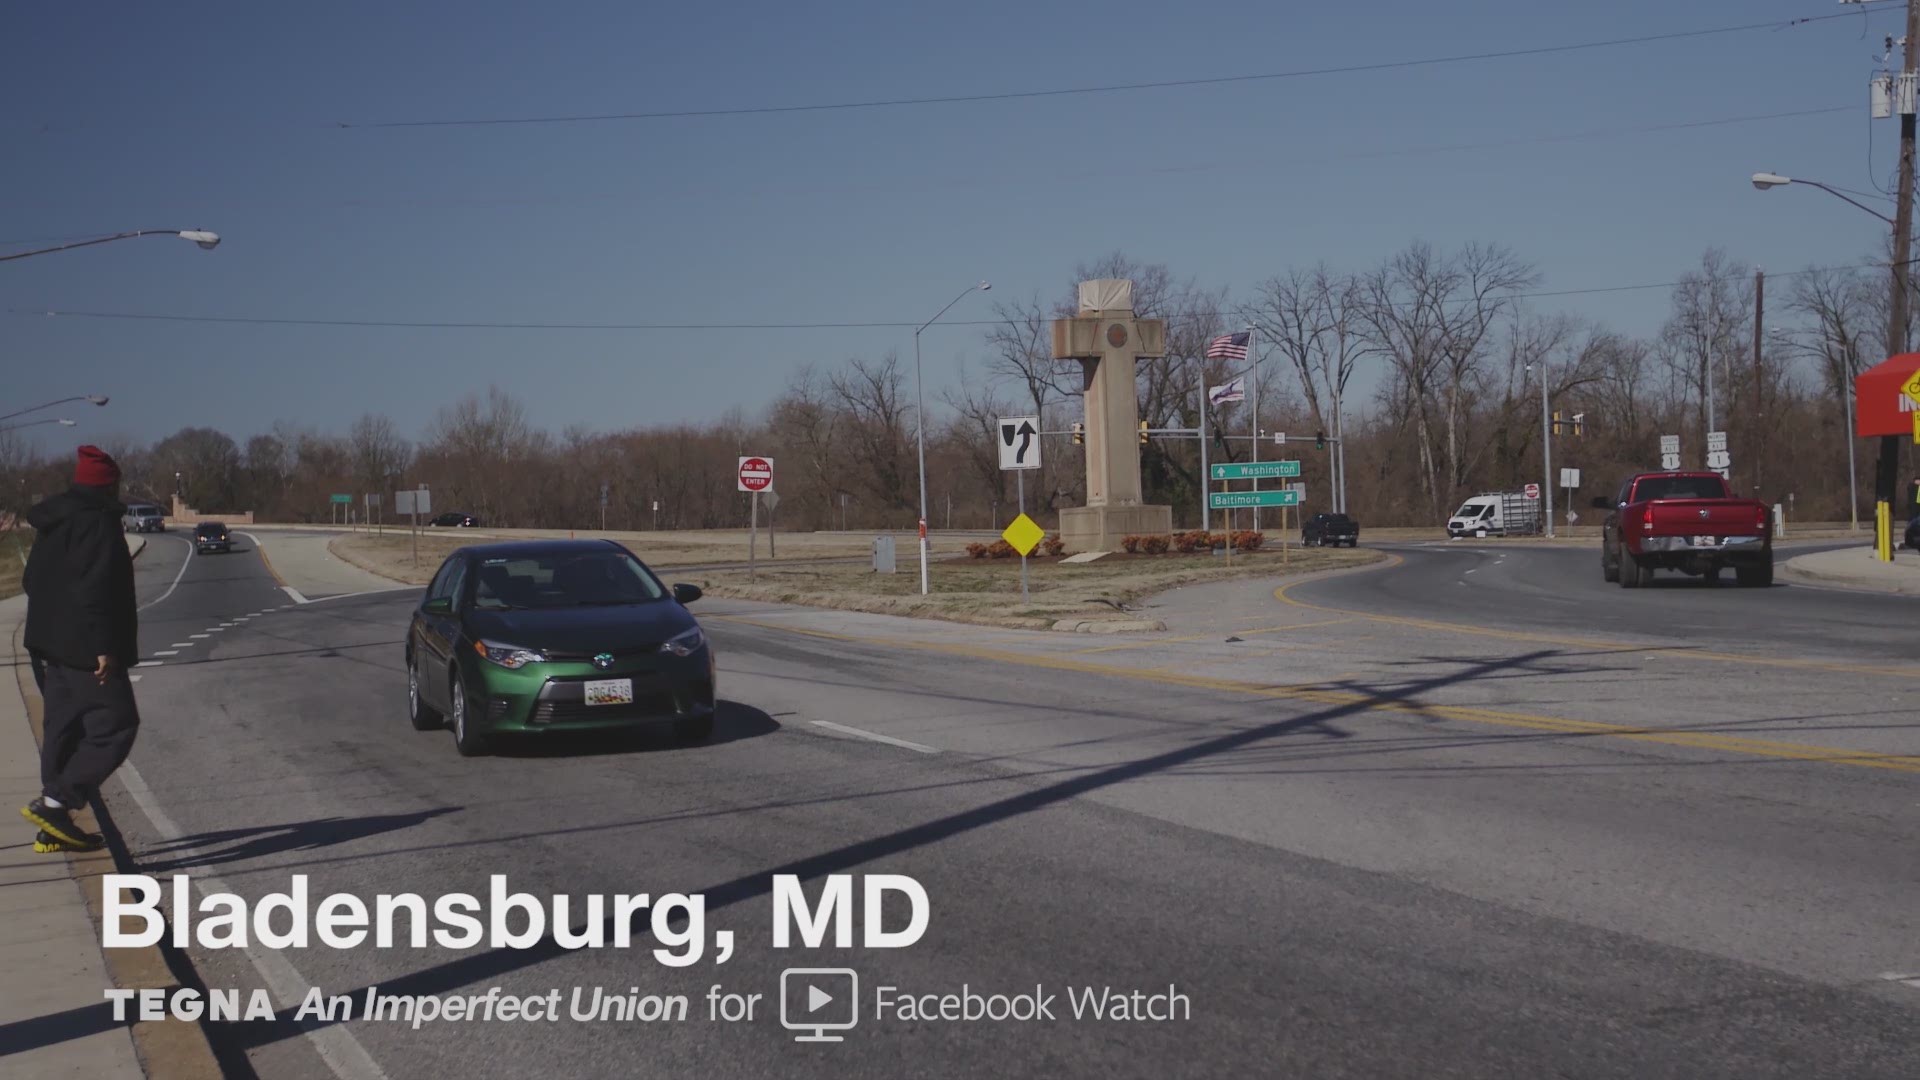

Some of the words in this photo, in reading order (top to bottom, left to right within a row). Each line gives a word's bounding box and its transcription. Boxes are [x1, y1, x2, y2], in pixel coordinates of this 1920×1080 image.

[1899, 393, 1920, 413] IN
[1240, 465, 1295, 477] Washington
[1215, 495, 1261, 505] Baltimore
